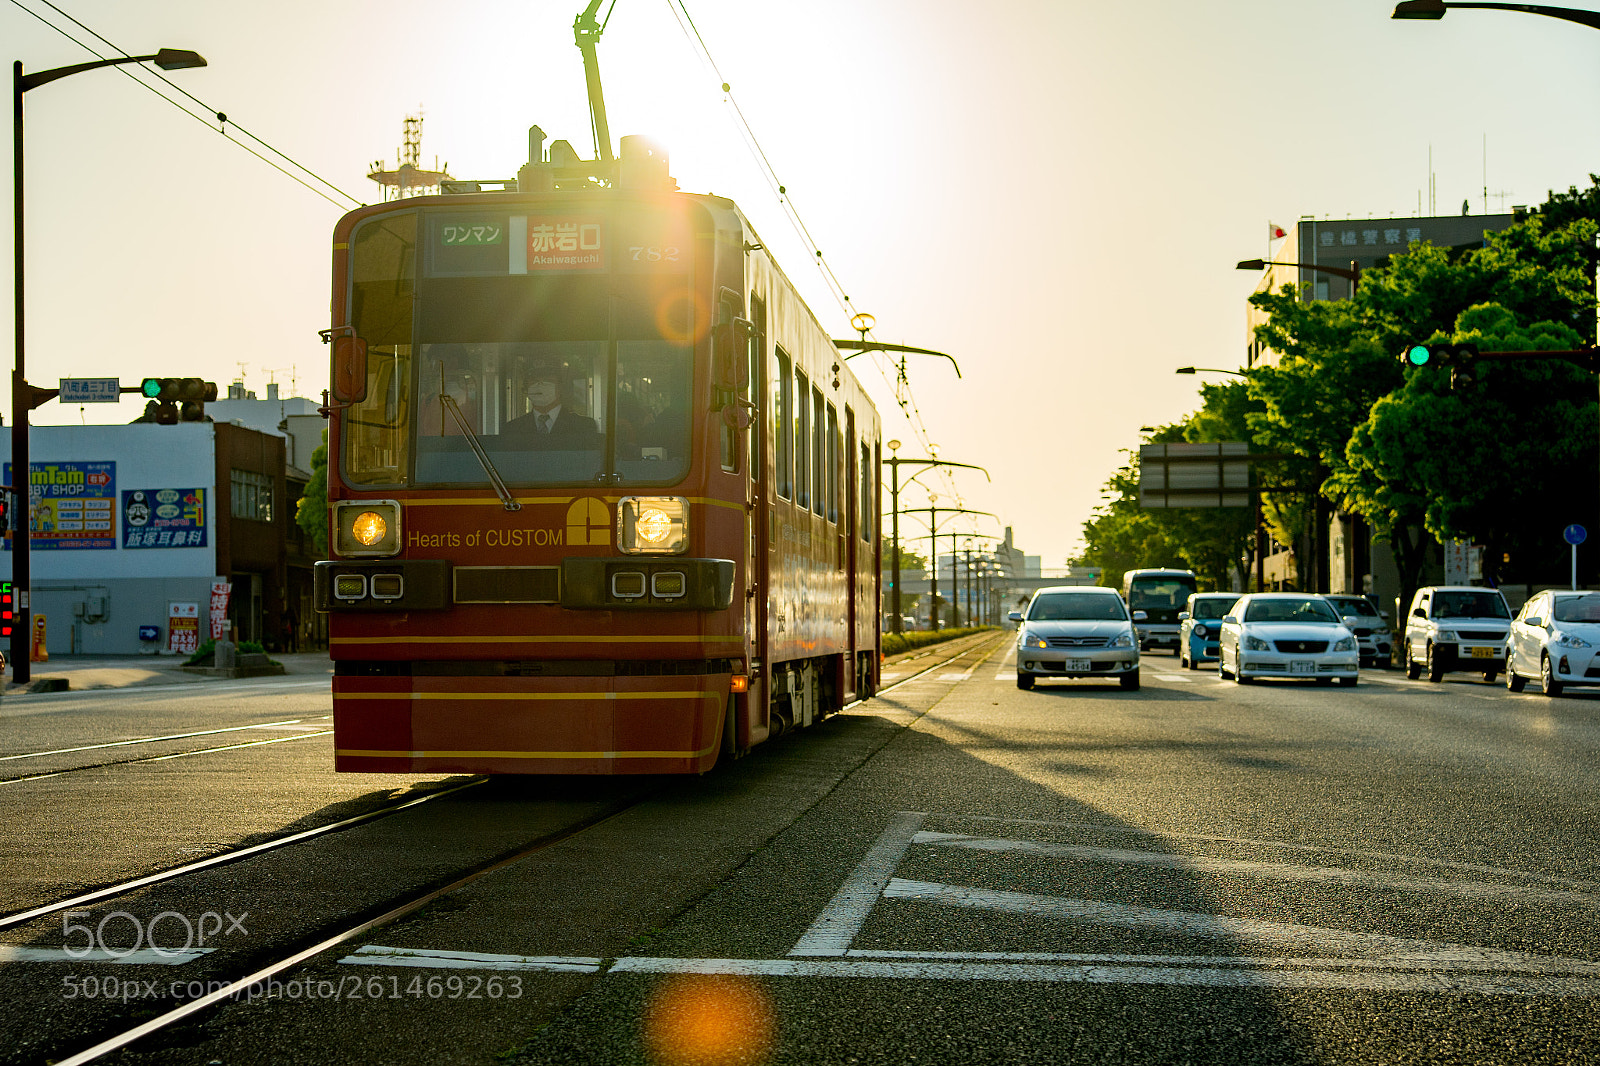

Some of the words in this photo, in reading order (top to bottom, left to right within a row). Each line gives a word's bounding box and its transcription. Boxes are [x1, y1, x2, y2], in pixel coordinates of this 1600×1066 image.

[443, 225, 501, 243] ワンマン
[531, 222, 601, 252] 赤岩口
[532, 253, 600, 266] Akaiwaguchi
[627, 246, 681, 262] 782
[62, 380, 117, 393] 八町通三丁目
[30, 466, 85, 485] mTam
[52, 484, 85, 496] SHOP
[126, 530, 202, 547] 飯塚耳鼻科
[408, 530, 461, 548] Hearts
[465, 530, 481, 547] of
[485, 528, 564, 547] CUSTOM
